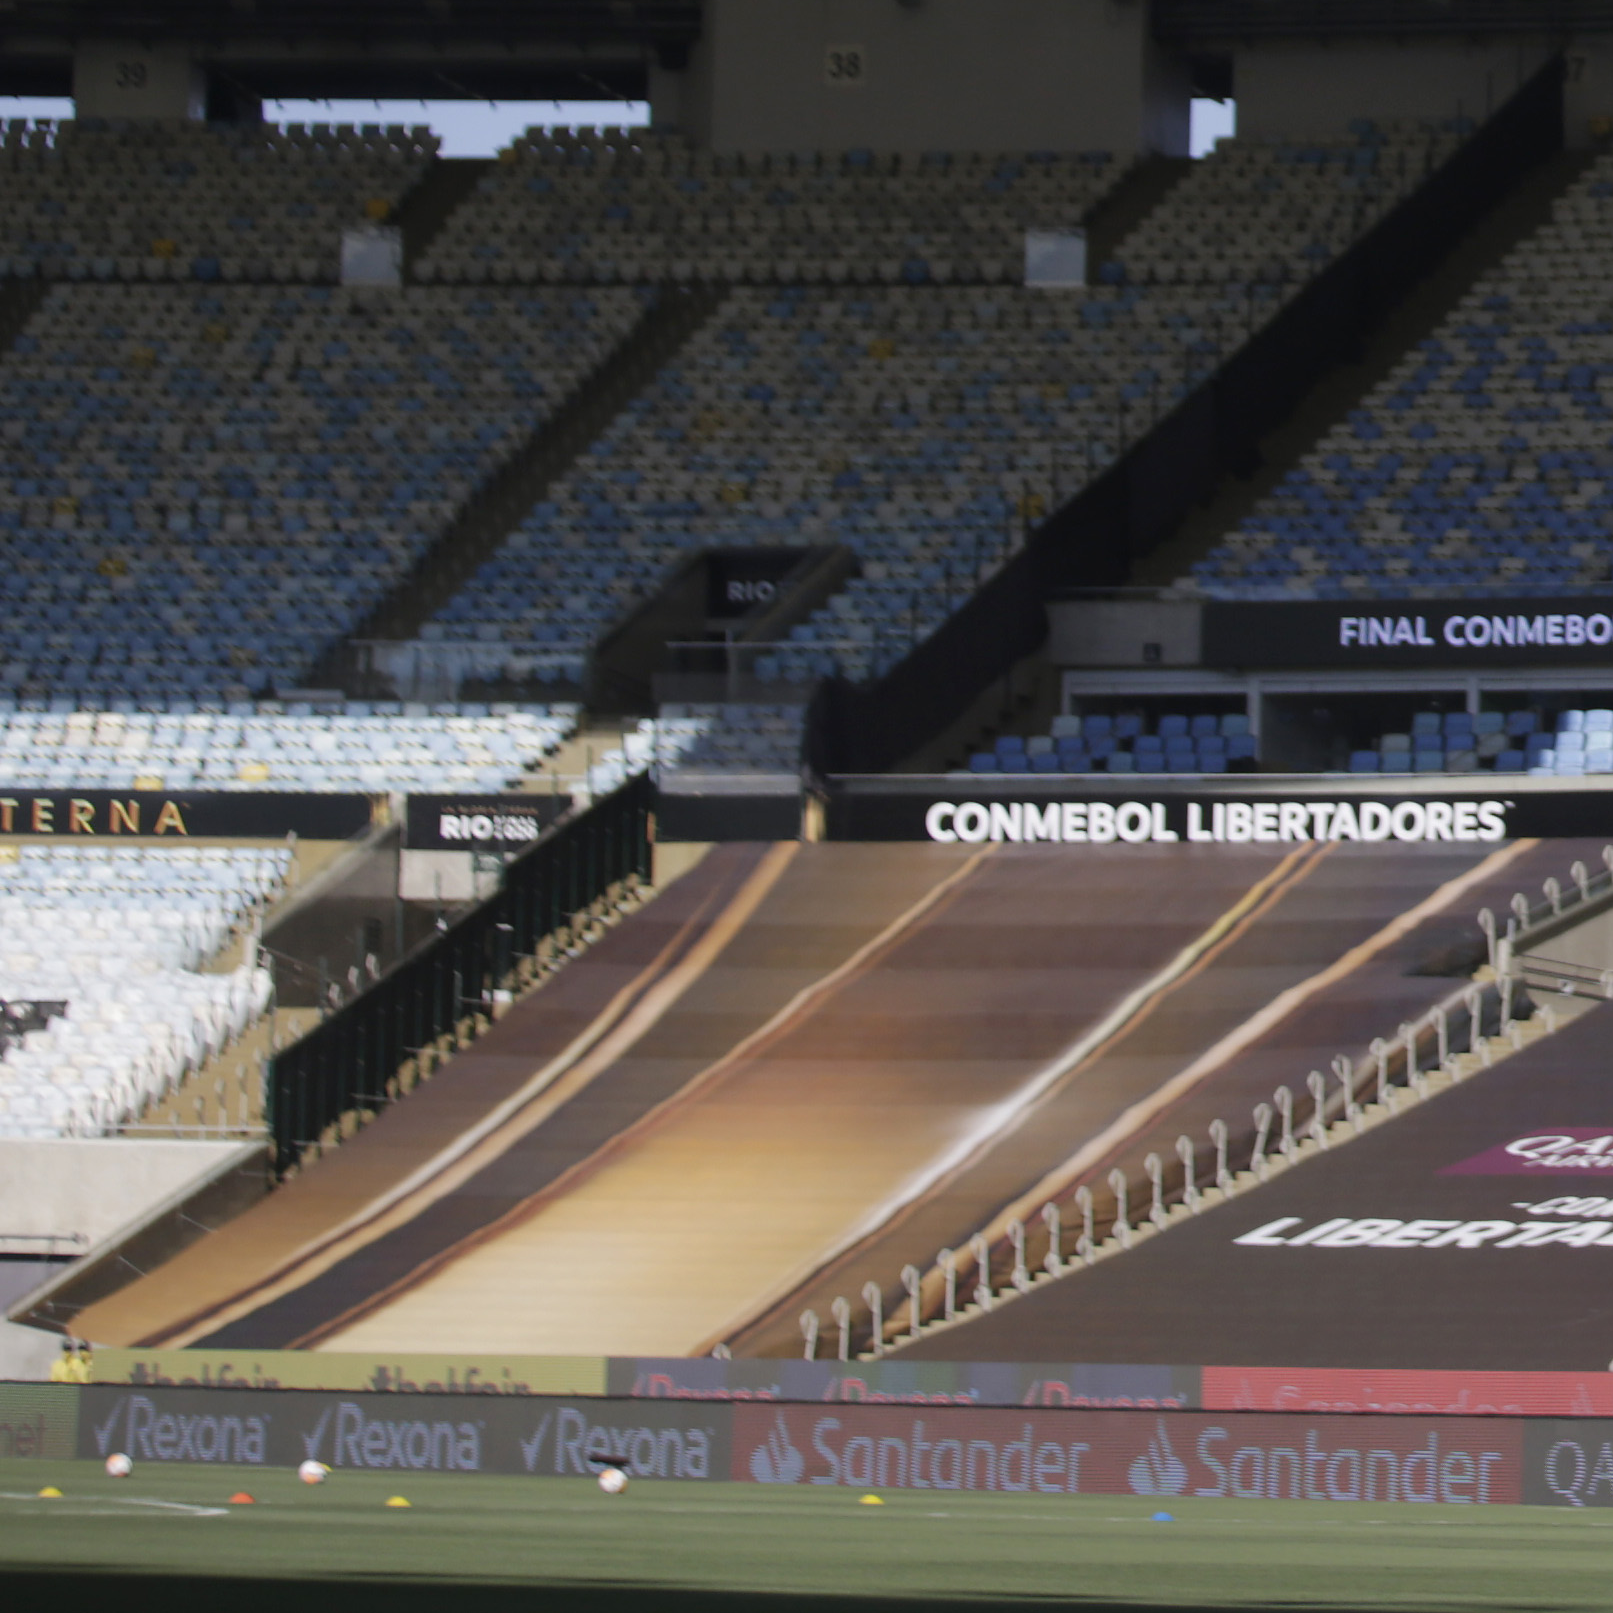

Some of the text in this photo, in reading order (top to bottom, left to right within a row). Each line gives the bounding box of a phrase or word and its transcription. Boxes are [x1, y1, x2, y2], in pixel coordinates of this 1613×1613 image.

[828, 52, 861, 78] 38
[1340, 616, 1434, 646] FINAL
[440, 814, 494, 840] RIO
[925, 801, 1506, 842] CONMEBOL LIBERTADORES
[124, 1395, 267, 1463] Rexona
[333, 1401, 482, 1470] Rexona
[554, 1407, 710, 1479] Rexona
[809, 1416, 1090, 1494] Santander
[1194, 1426, 1503, 1504] Santander
